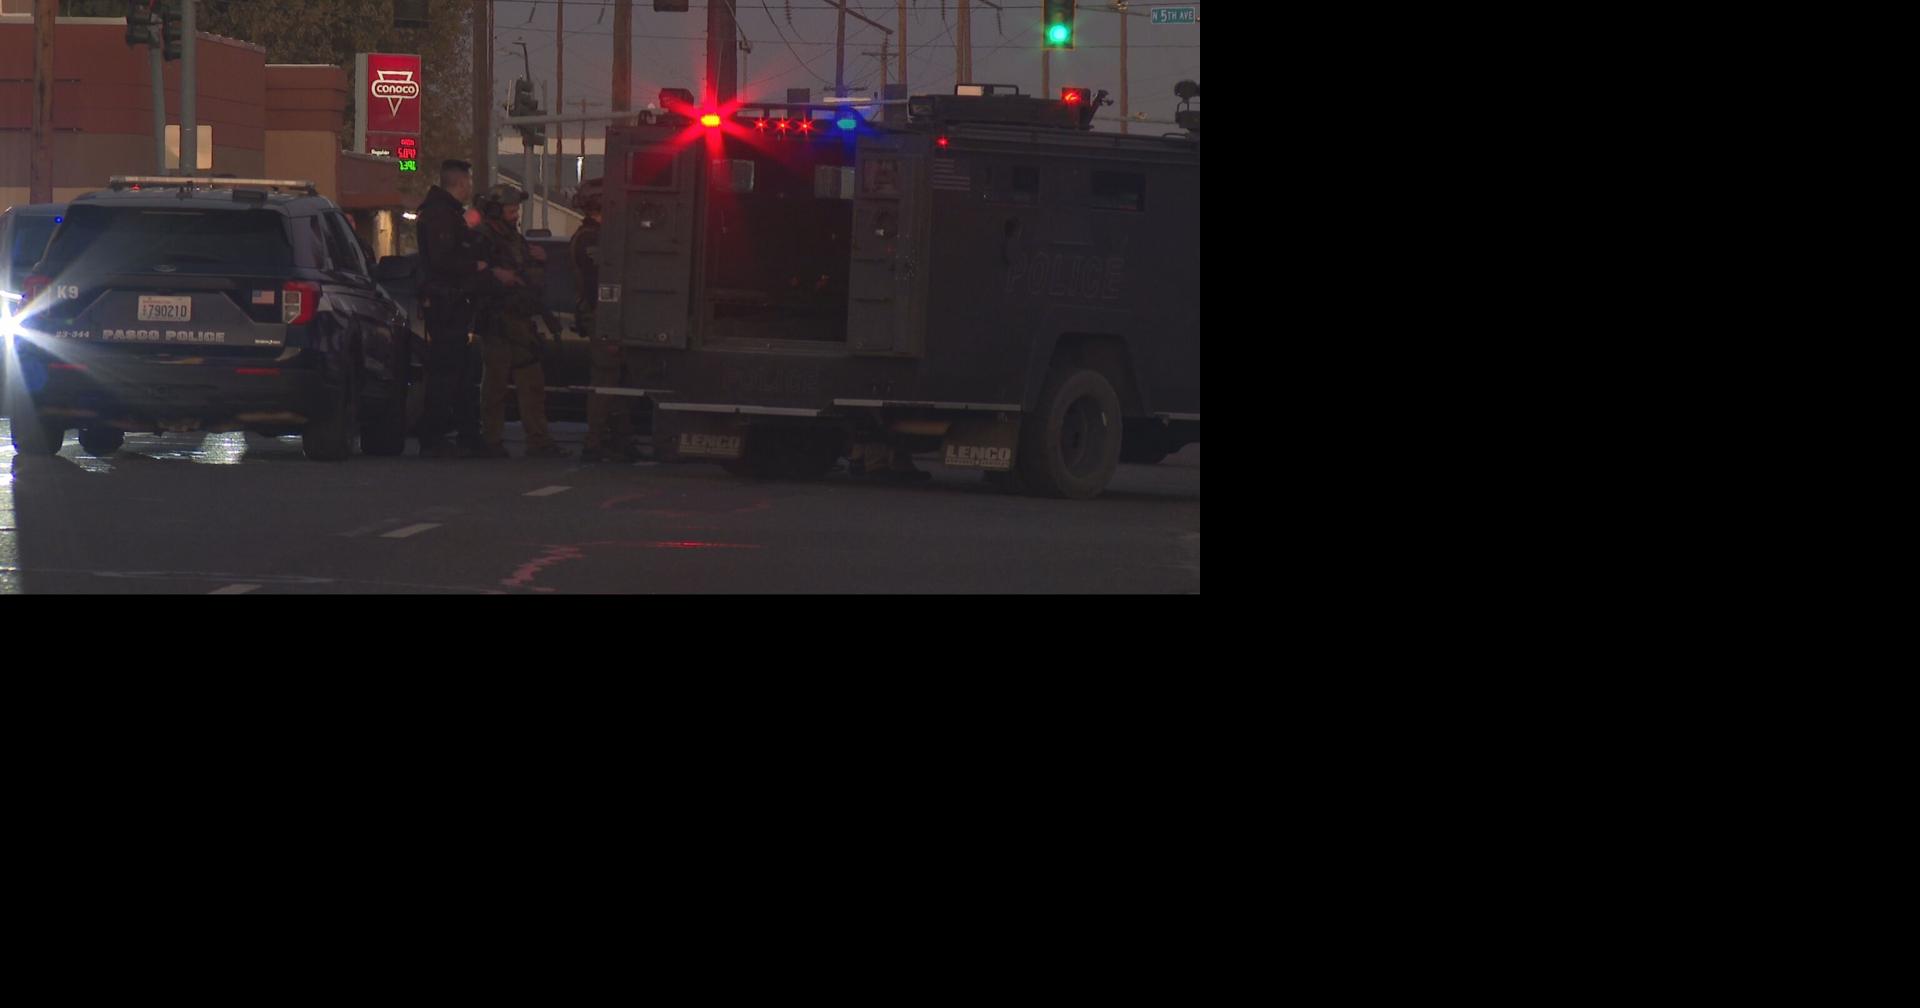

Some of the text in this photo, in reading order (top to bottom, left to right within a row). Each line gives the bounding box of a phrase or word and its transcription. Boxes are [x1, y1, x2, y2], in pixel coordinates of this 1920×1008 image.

[1152, 9, 1193, 22] N 5TH AVE
[1004, 251, 1122, 300] POLICE
[57, 286, 79, 299] K9
[102, 329, 226, 343] PASCO POLICE
[680, 432, 741, 448] LENCO
[946, 444, 1012, 460] LENCO
